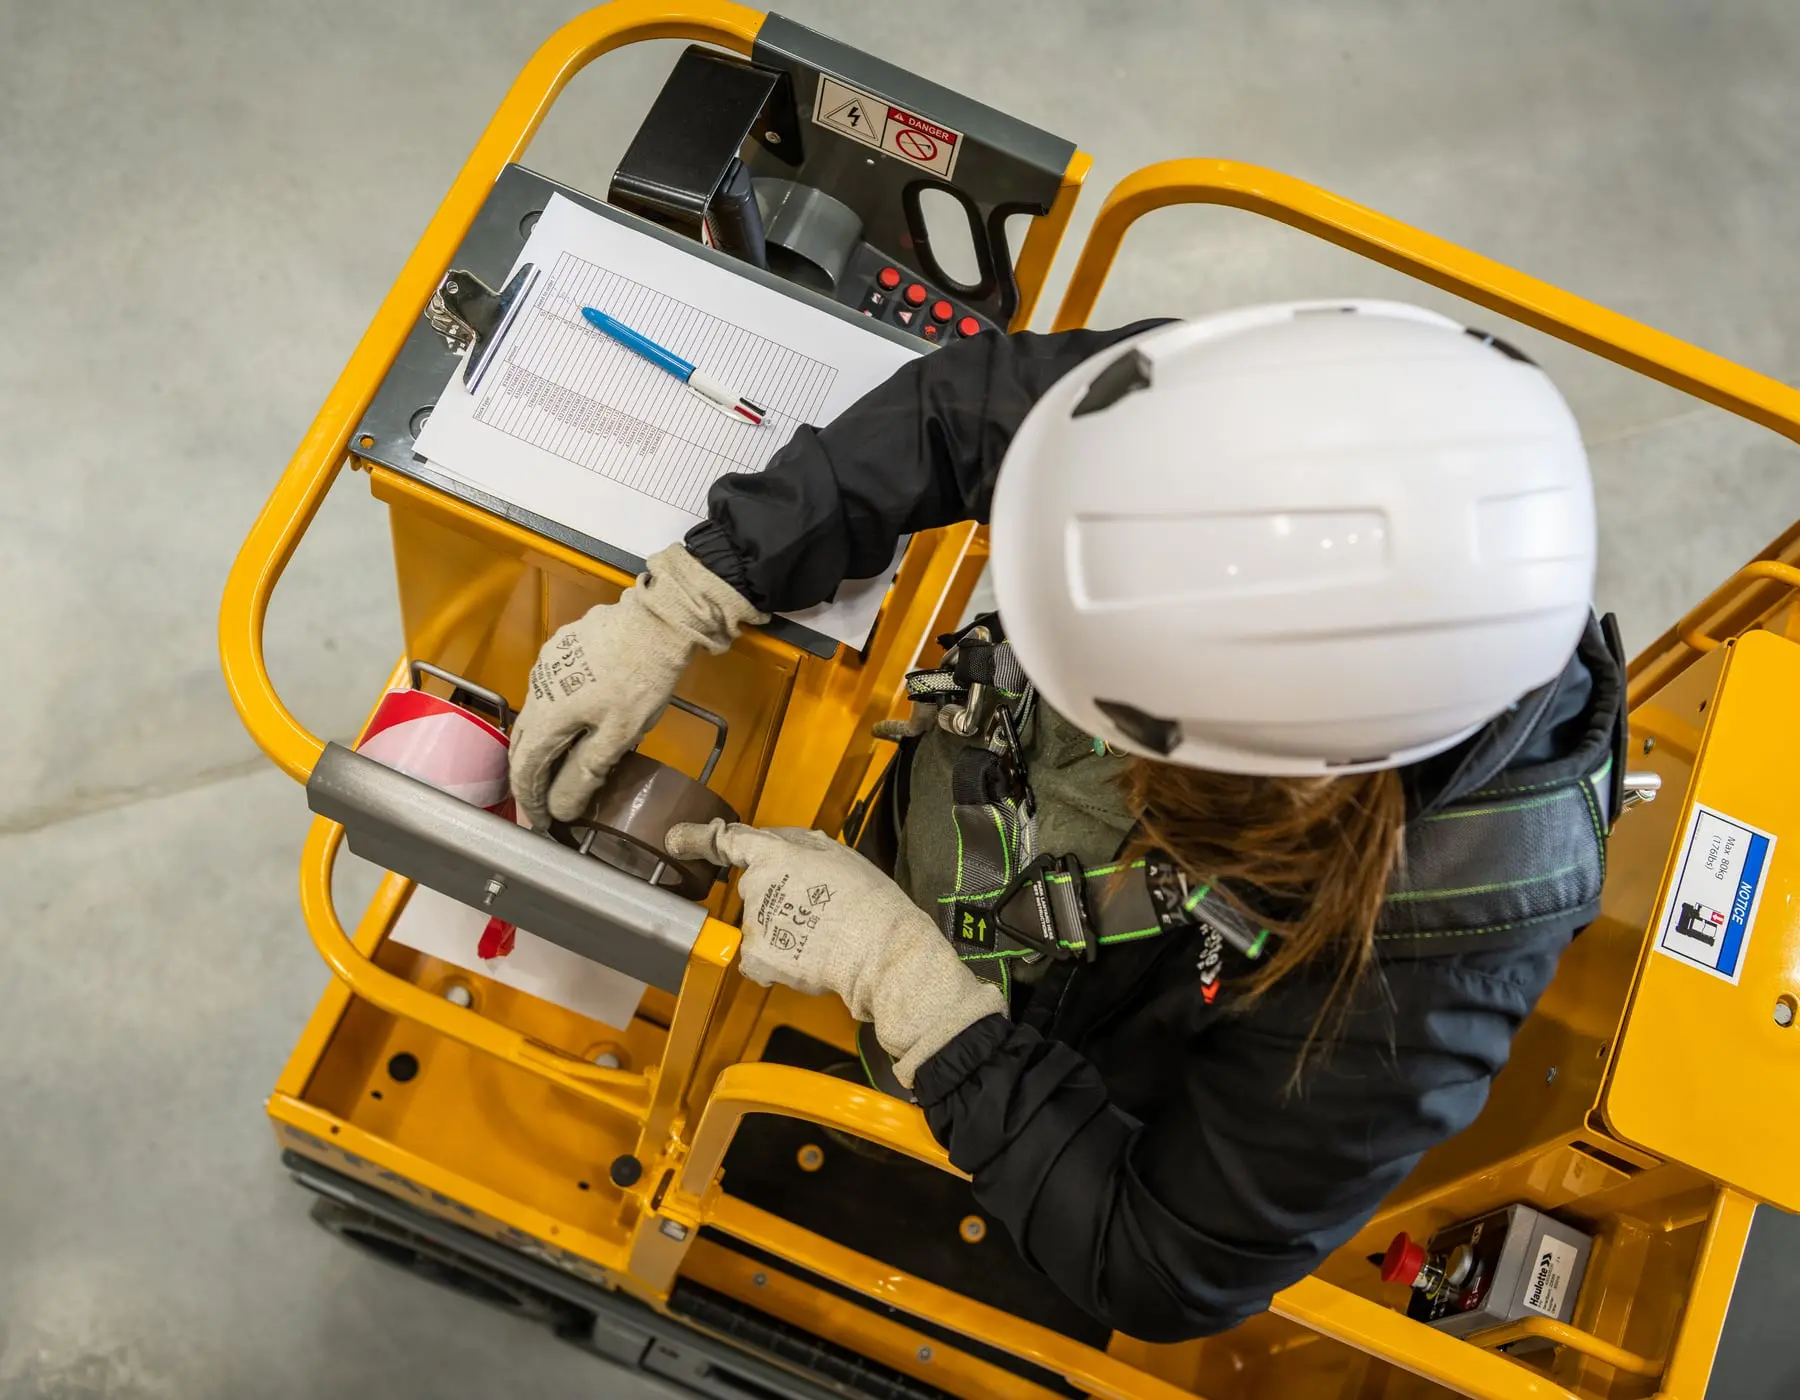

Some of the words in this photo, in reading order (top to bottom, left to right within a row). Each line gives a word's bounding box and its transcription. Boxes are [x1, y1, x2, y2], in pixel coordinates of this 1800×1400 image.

[908, 117, 949, 141] DANGER
[506, 344, 518, 362] amount
[474, 406, 485, 420] Stock
[481, 395, 492, 408] type
[1704, 835, 1722, 871] (176lbs)
[1723, 836, 1736, 856] Max
[1714, 859, 1730, 881] 80kg
[778, 902, 794, 917] T9
[793, 905, 812, 926] CE
[1040, 897, 1050, 923] LANYARD
[1732, 881, 1753, 926] NOTICE
[962, 911, 975, 939] A/2
[1529, 1267, 1548, 1307] Haulotte
